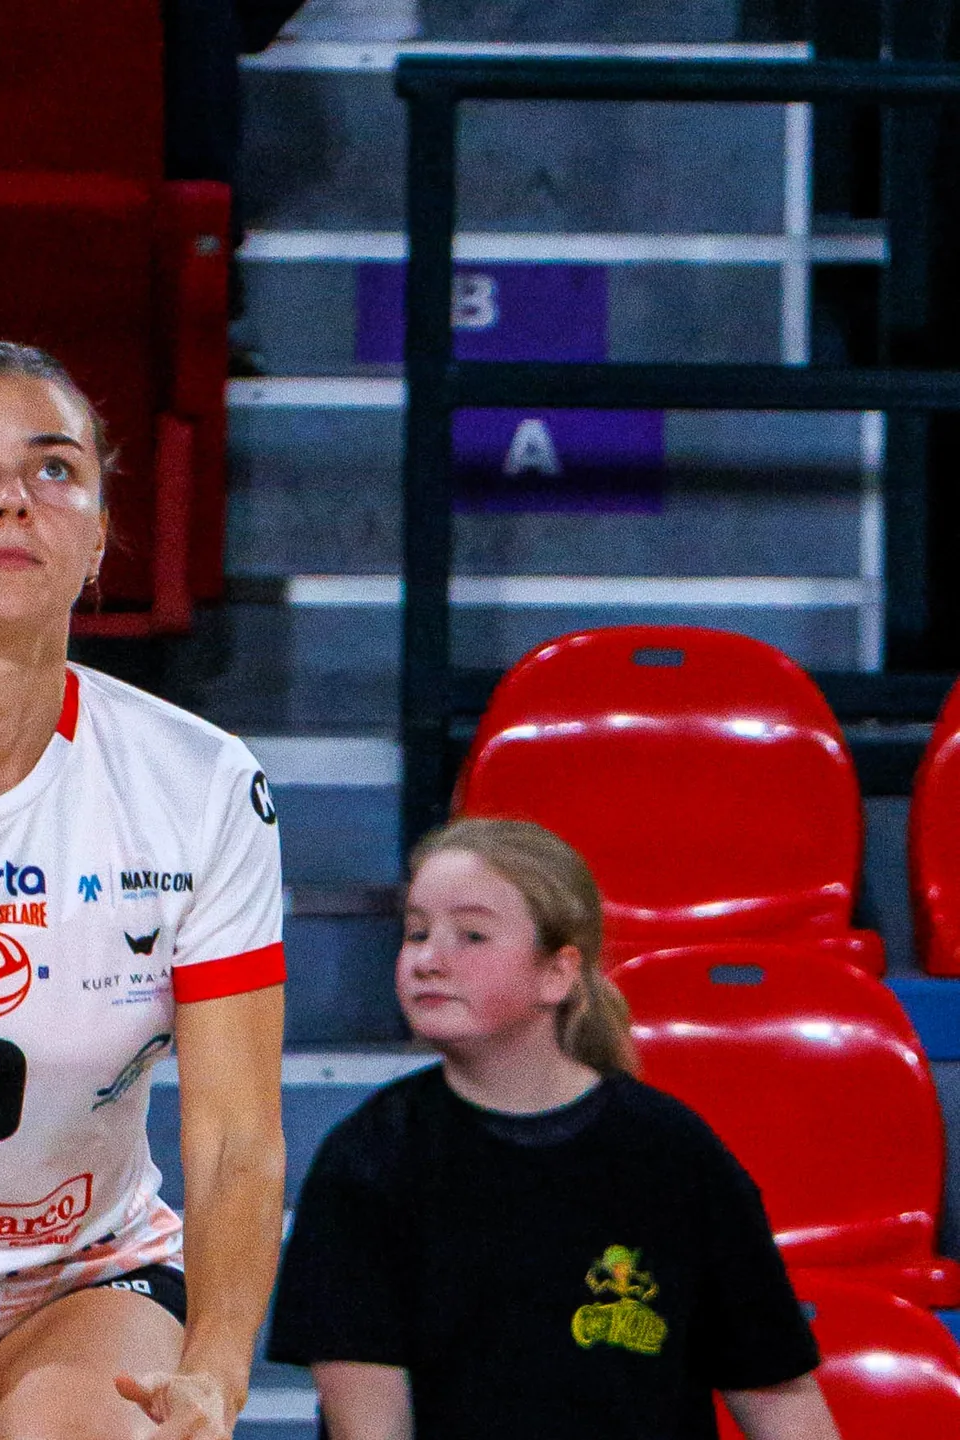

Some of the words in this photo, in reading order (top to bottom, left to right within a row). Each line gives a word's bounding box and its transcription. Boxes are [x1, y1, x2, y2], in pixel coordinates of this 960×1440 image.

[450, 272, 499, 328] B
[502, 418, 562, 475] A
[120, 870, 195, 893] MAXICON
[82, 974, 122, 992] KURT
